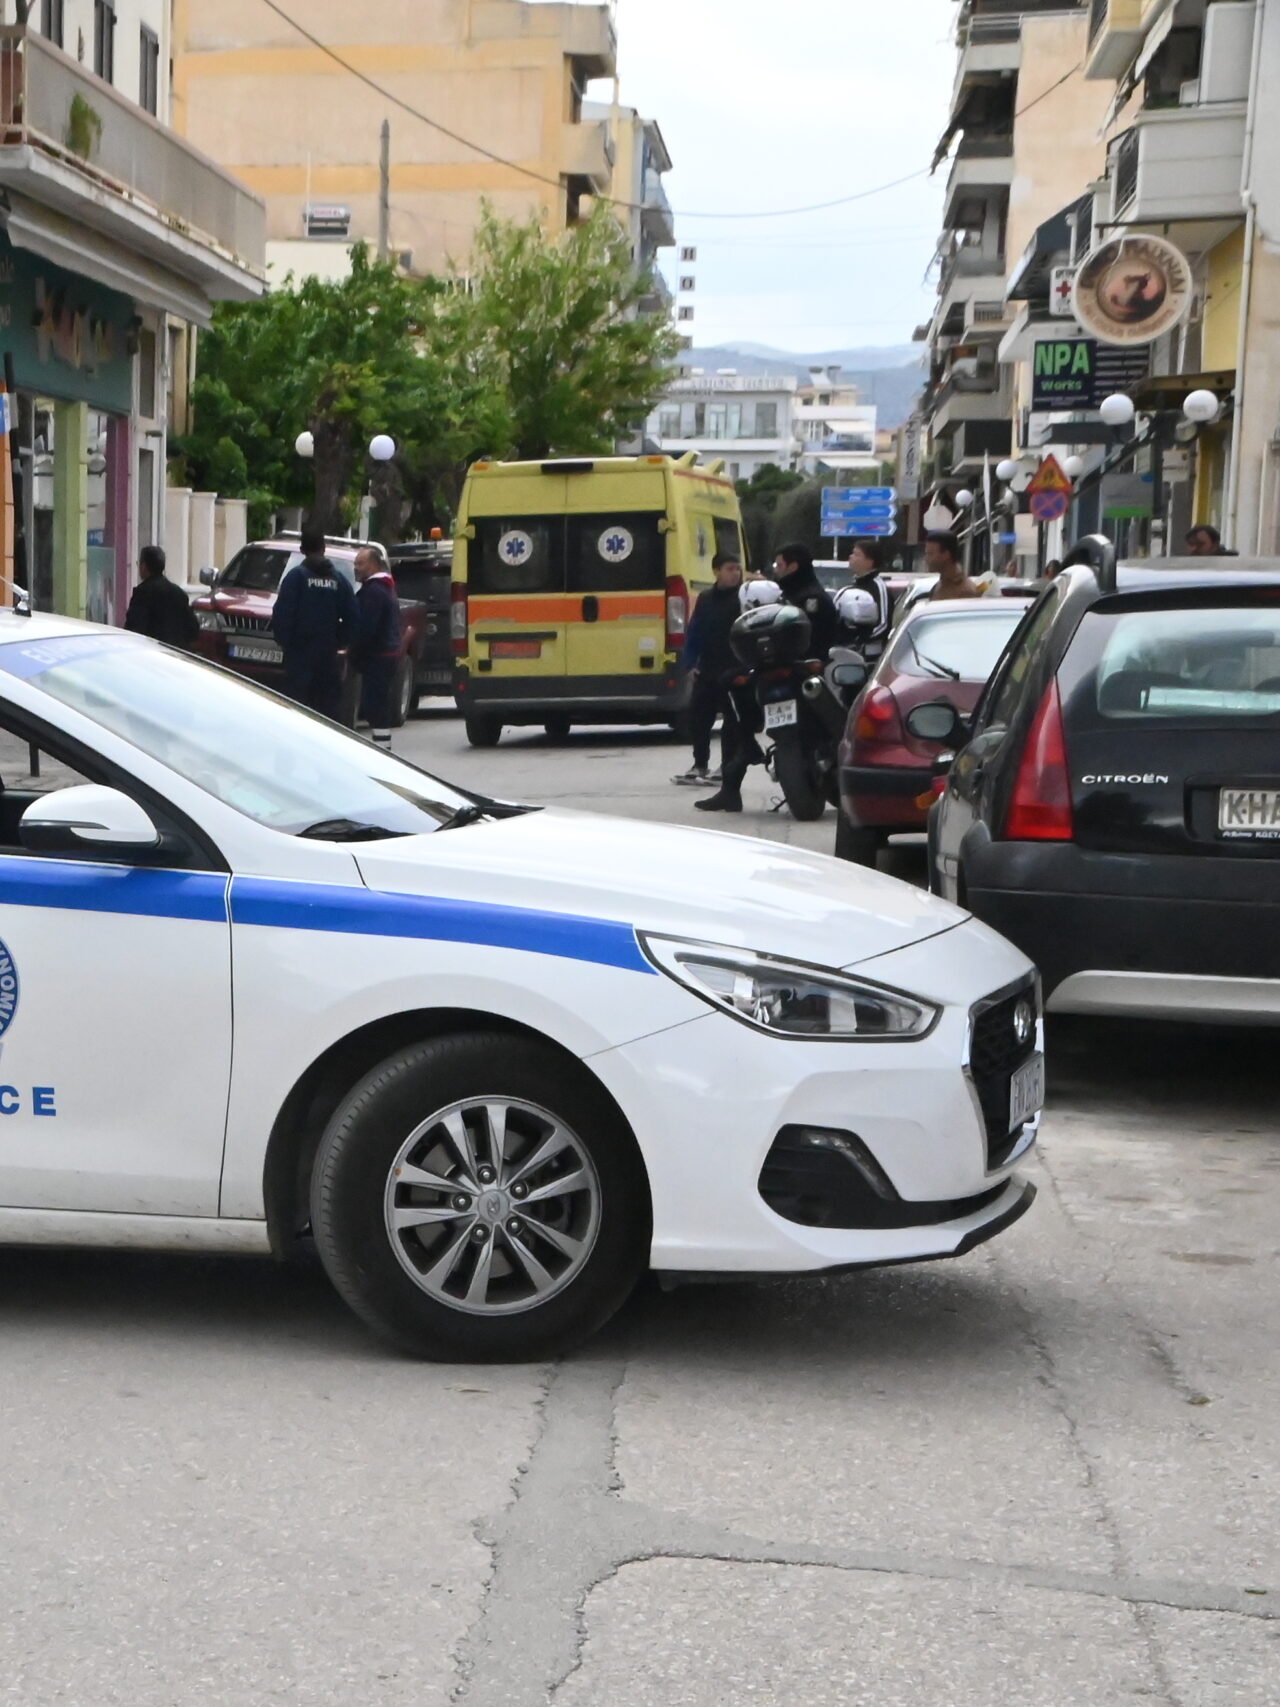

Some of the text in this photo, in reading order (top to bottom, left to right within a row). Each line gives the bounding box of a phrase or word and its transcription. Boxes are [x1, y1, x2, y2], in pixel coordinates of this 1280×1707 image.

[1034, 342, 1090, 376] NPA
[307, 578, 338, 590] POLICE
[1081, 774, 1169, 784] CITROËN
